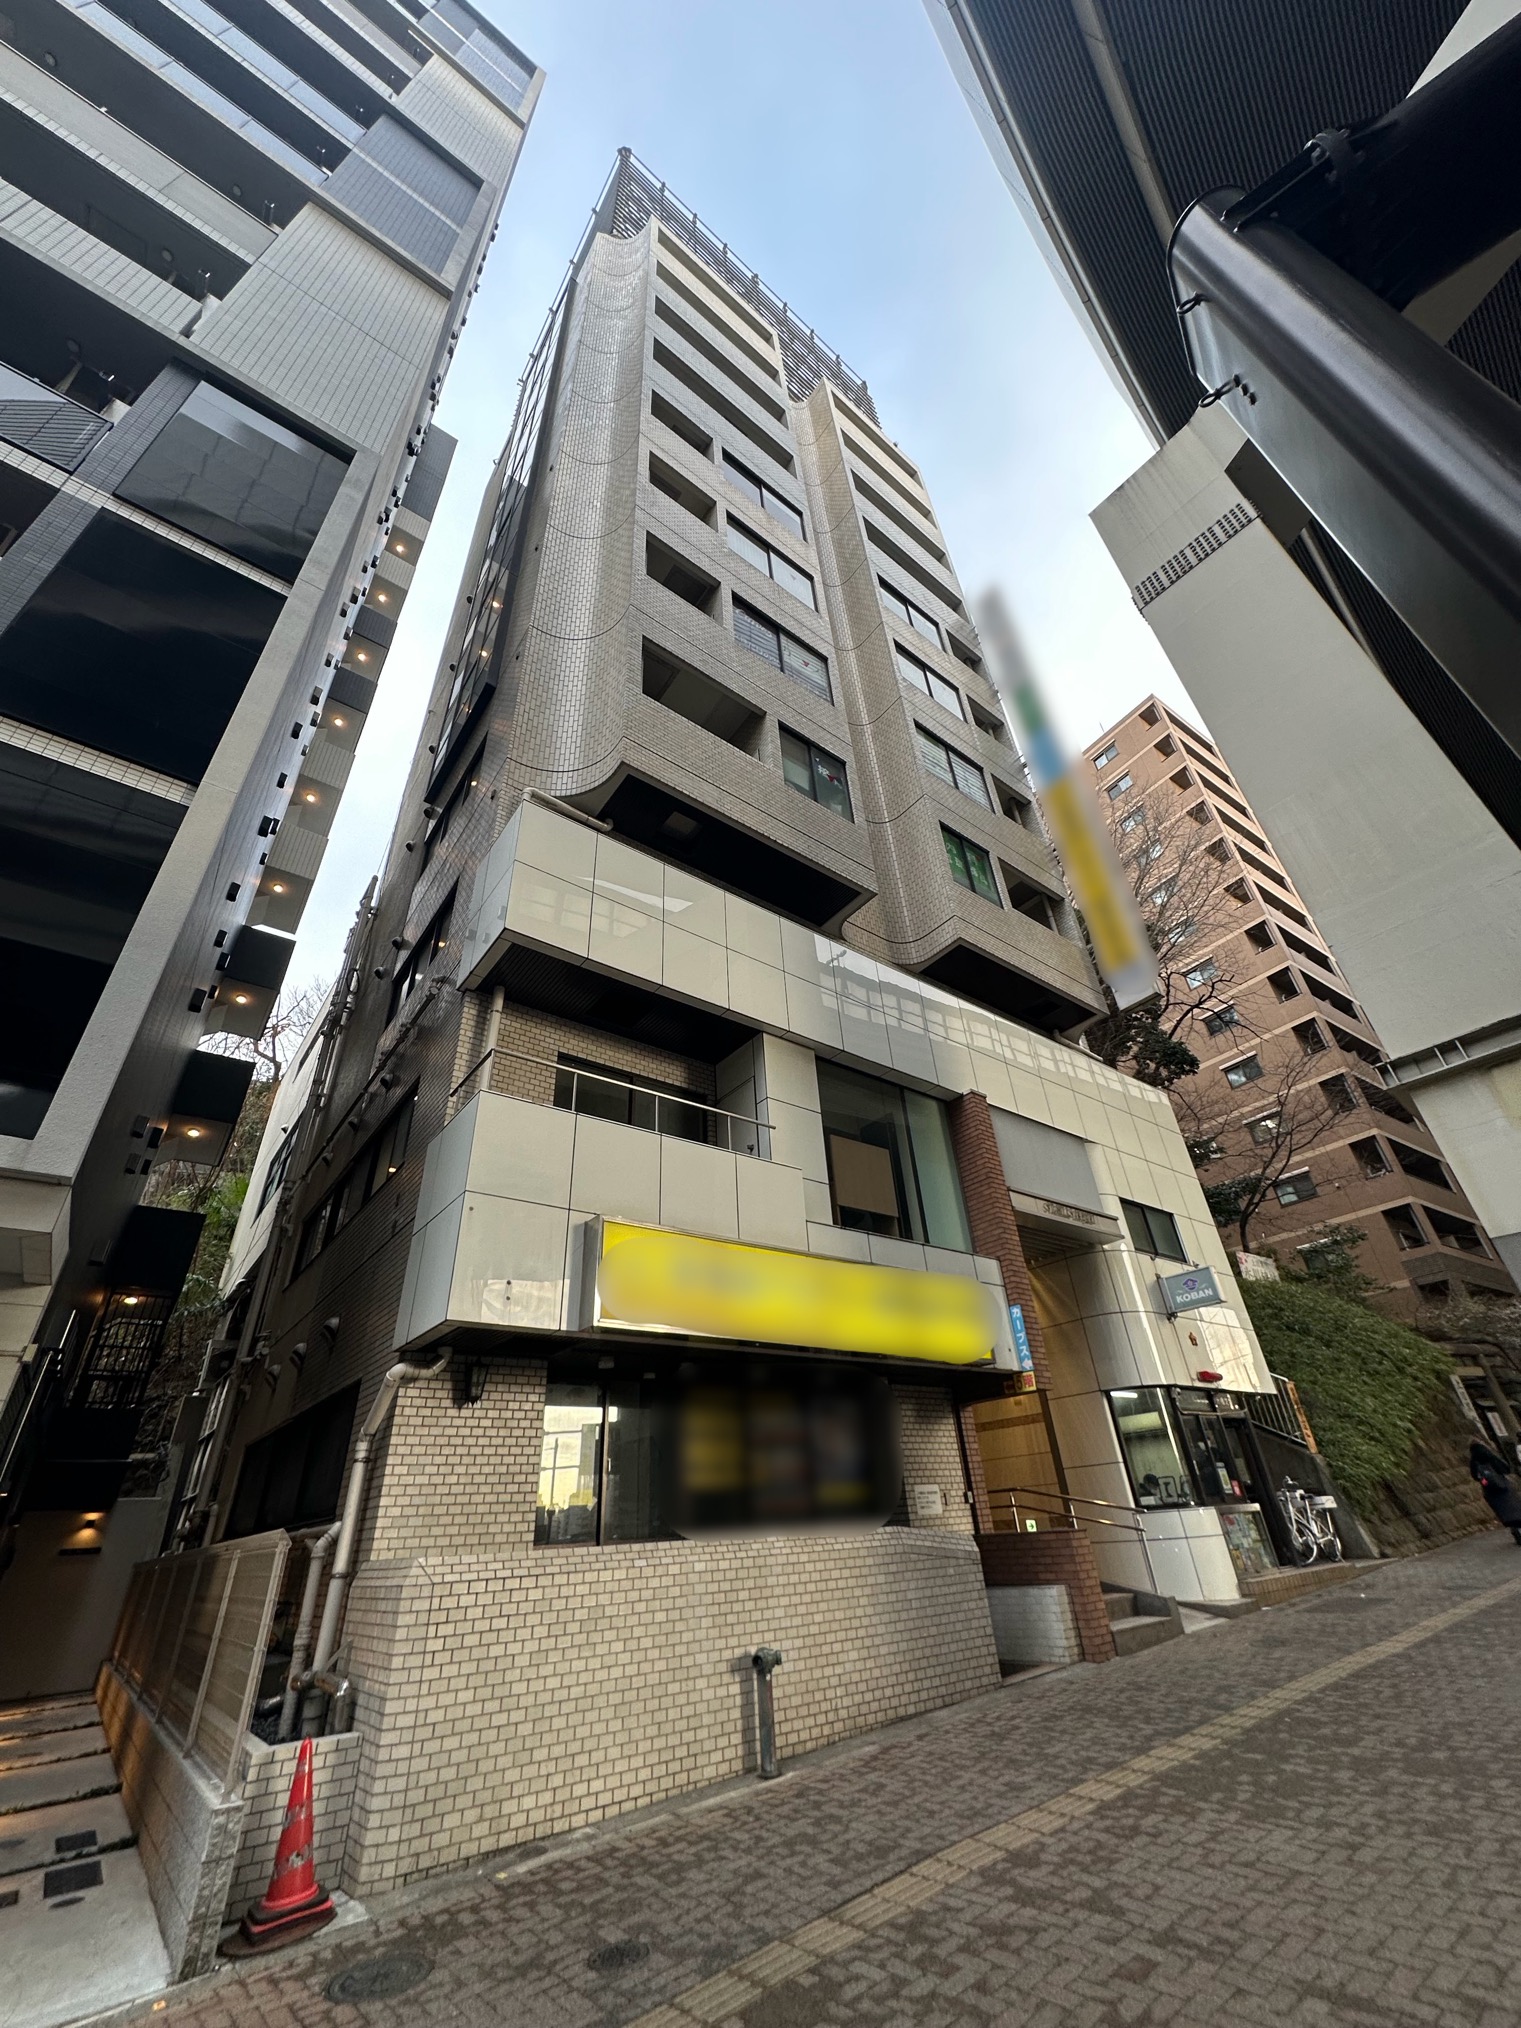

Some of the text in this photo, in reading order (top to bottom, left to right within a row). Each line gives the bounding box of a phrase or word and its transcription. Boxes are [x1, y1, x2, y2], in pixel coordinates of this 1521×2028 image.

[1176, 1288, 1213, 1304] KOBAN
[1011, 1307, 1029, 1356] カーブス
